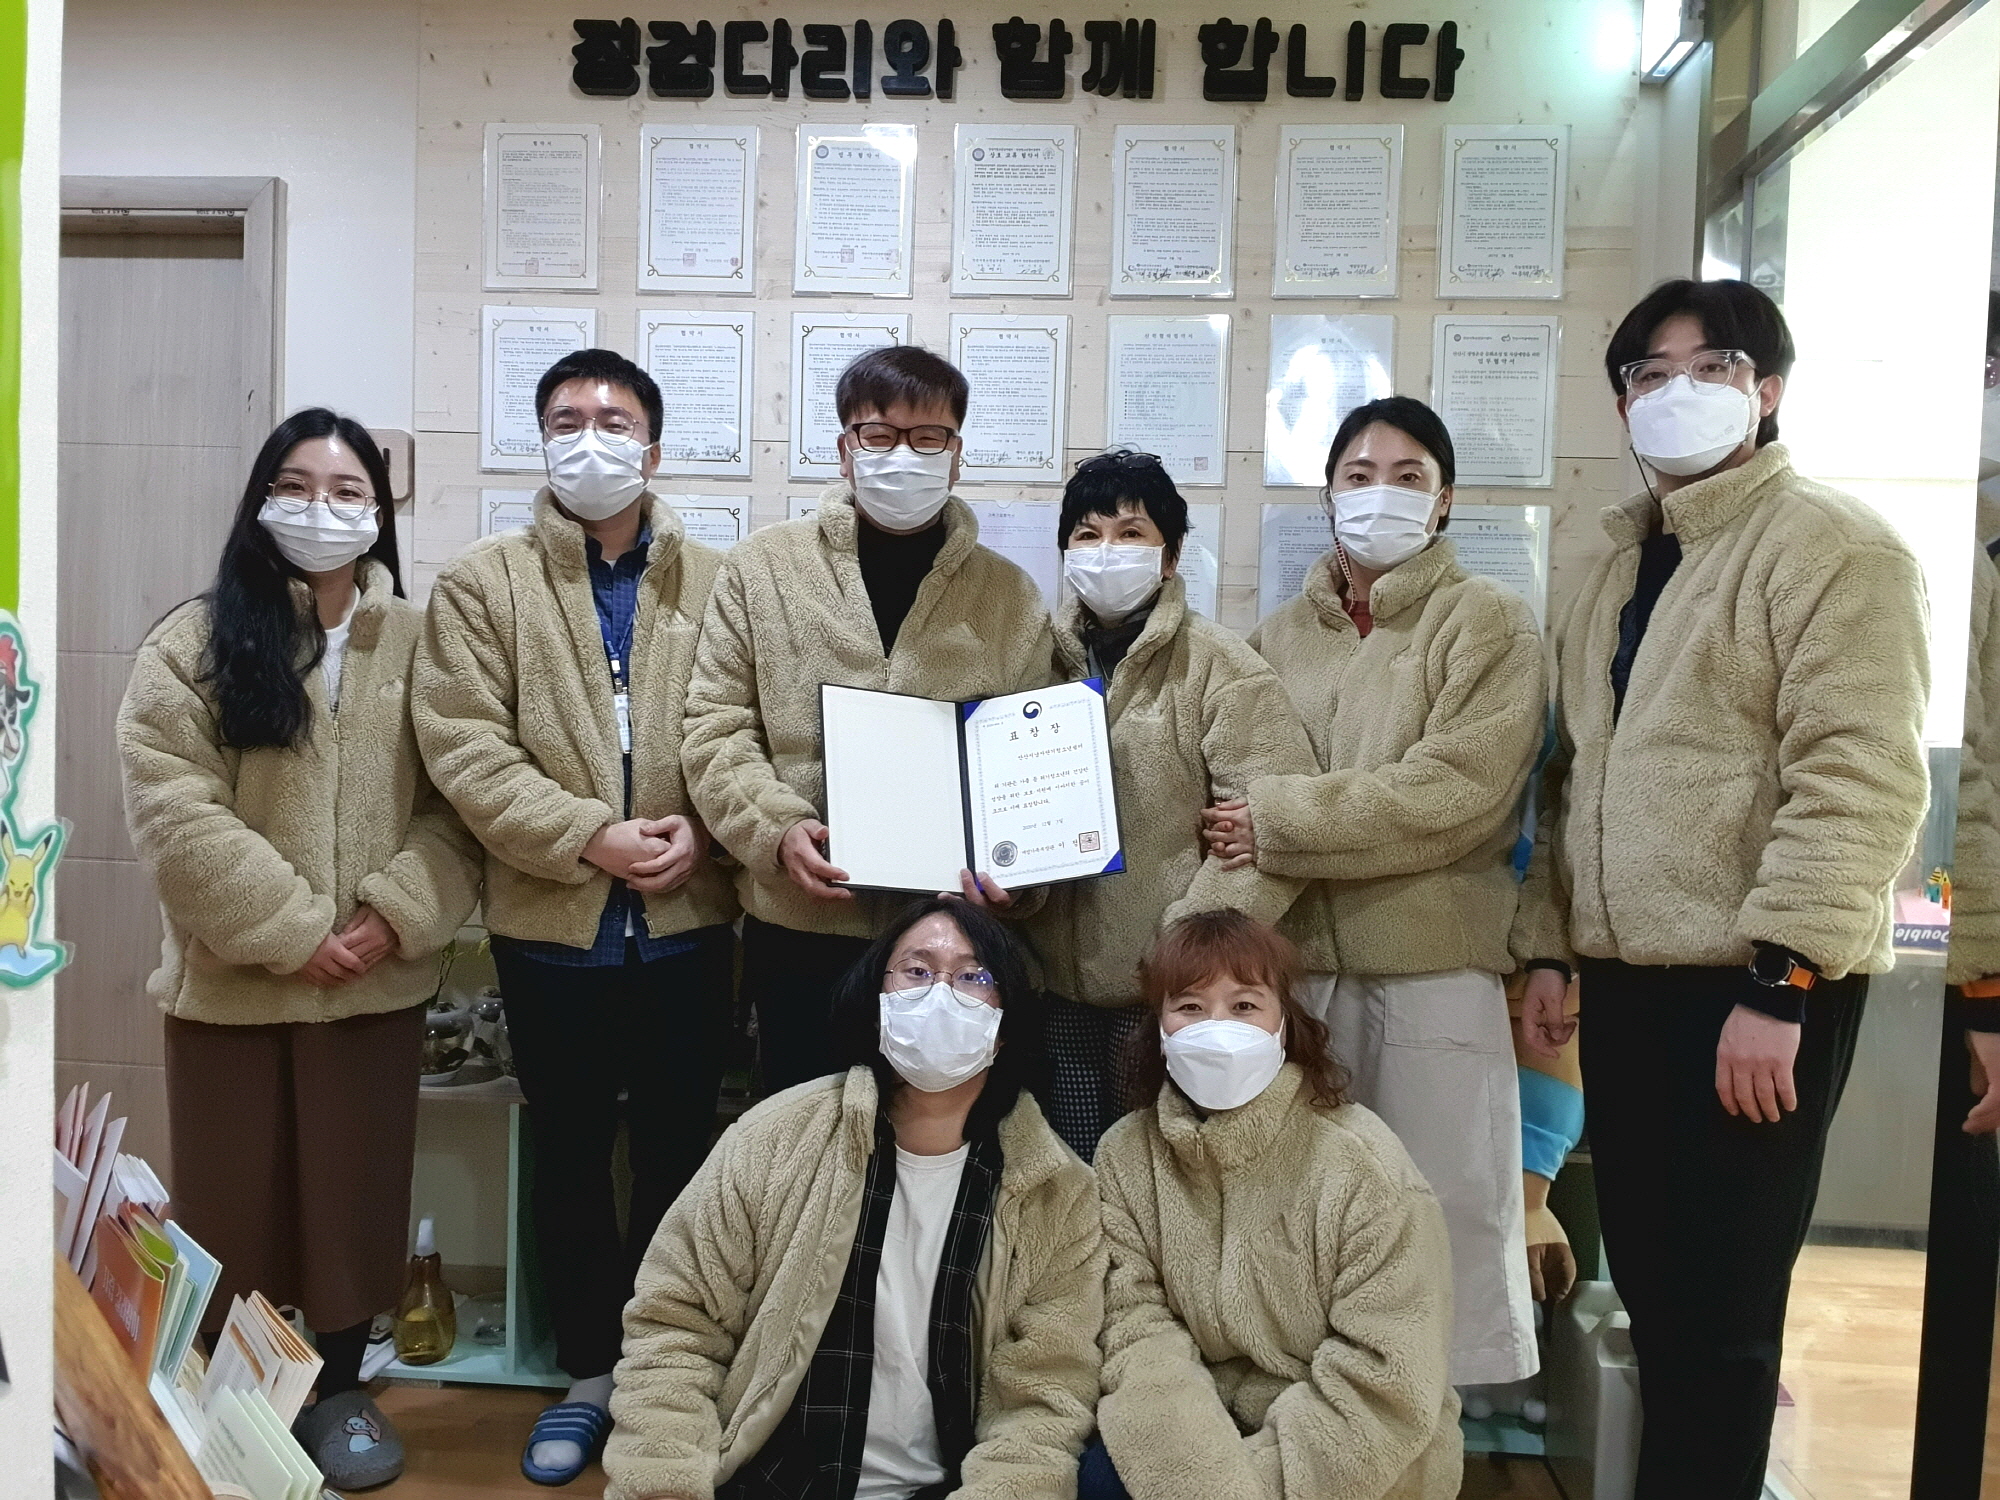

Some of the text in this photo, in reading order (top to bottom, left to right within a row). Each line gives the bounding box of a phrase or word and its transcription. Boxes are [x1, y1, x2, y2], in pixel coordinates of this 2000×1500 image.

[571, 16, 1466, 102] 징검다리와 함께 합니다
